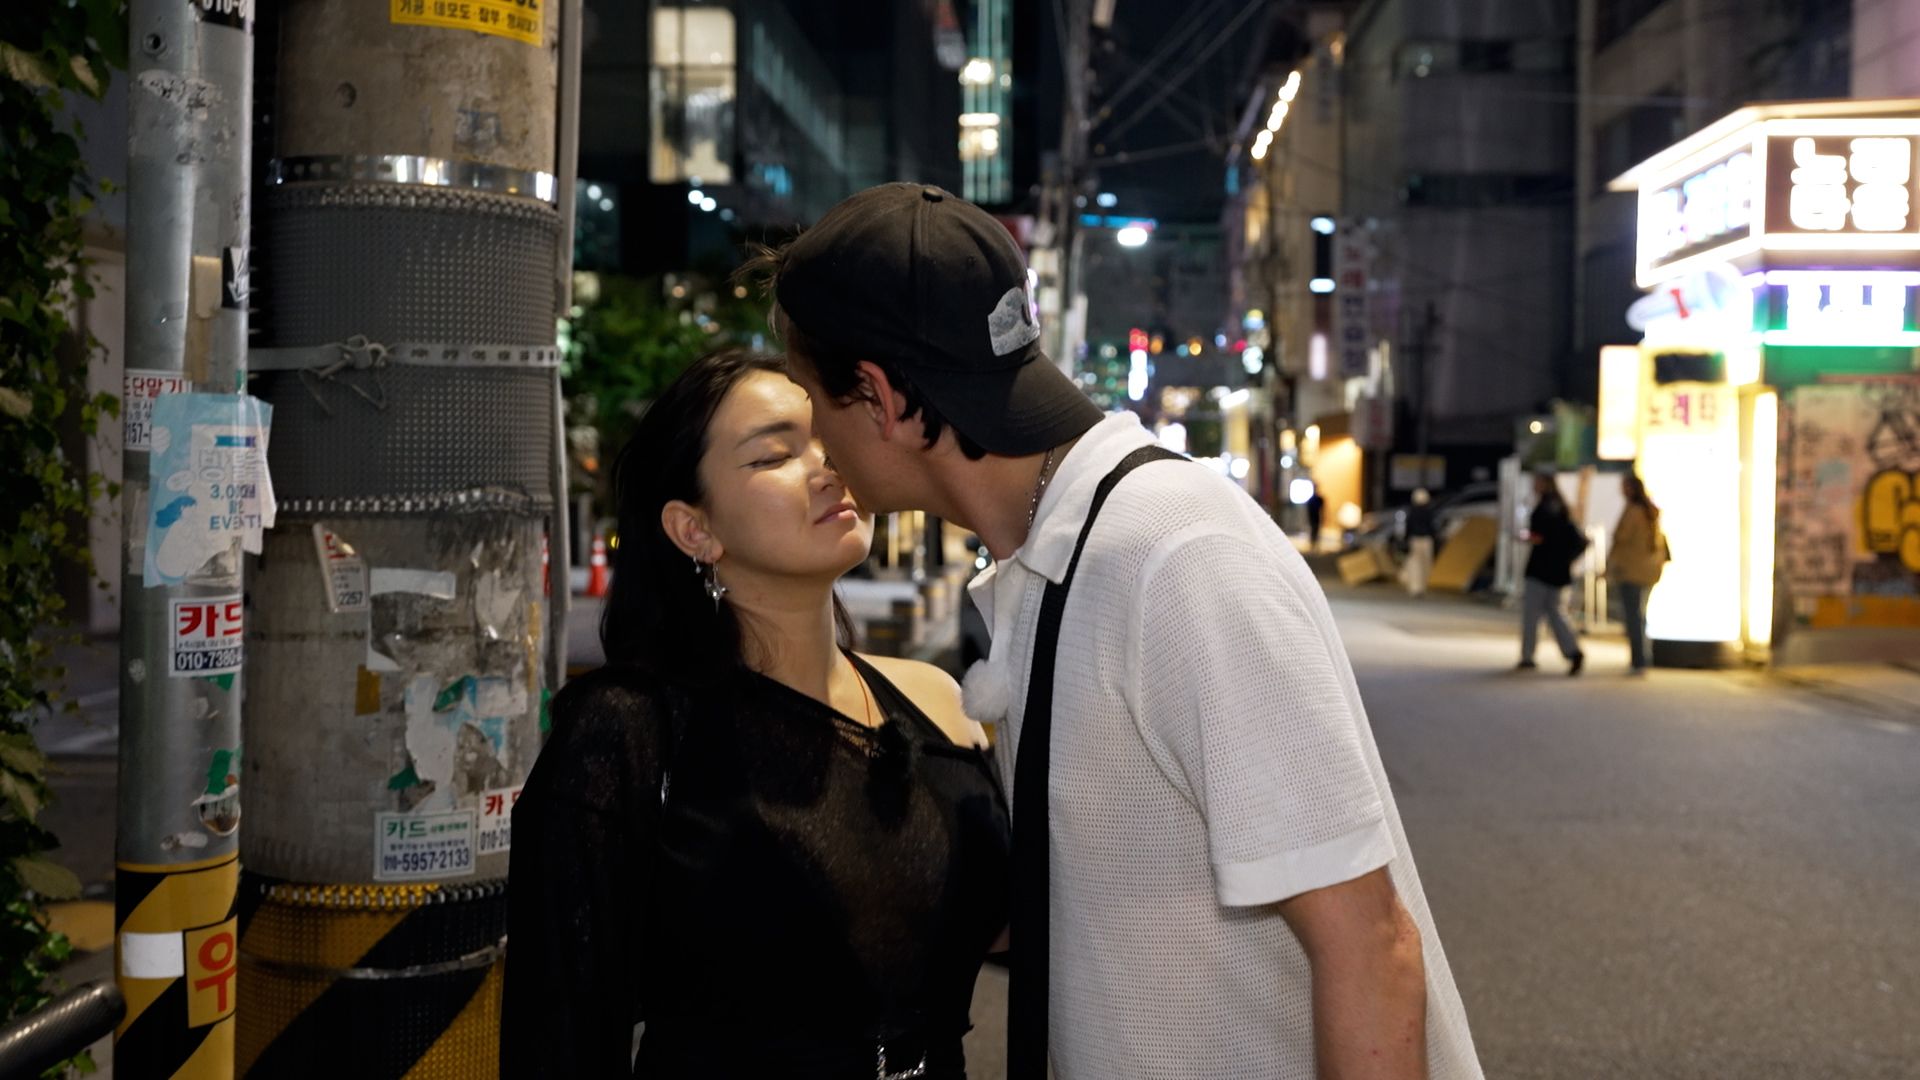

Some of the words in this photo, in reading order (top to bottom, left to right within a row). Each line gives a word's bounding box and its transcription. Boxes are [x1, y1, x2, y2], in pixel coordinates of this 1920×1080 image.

[179, 602, 241, 638] 카드
[386, 821, 427, 839] 카드
[383, 847, 470, 872] 010-5957-2133
[194, 932, 237, 1013] 우
